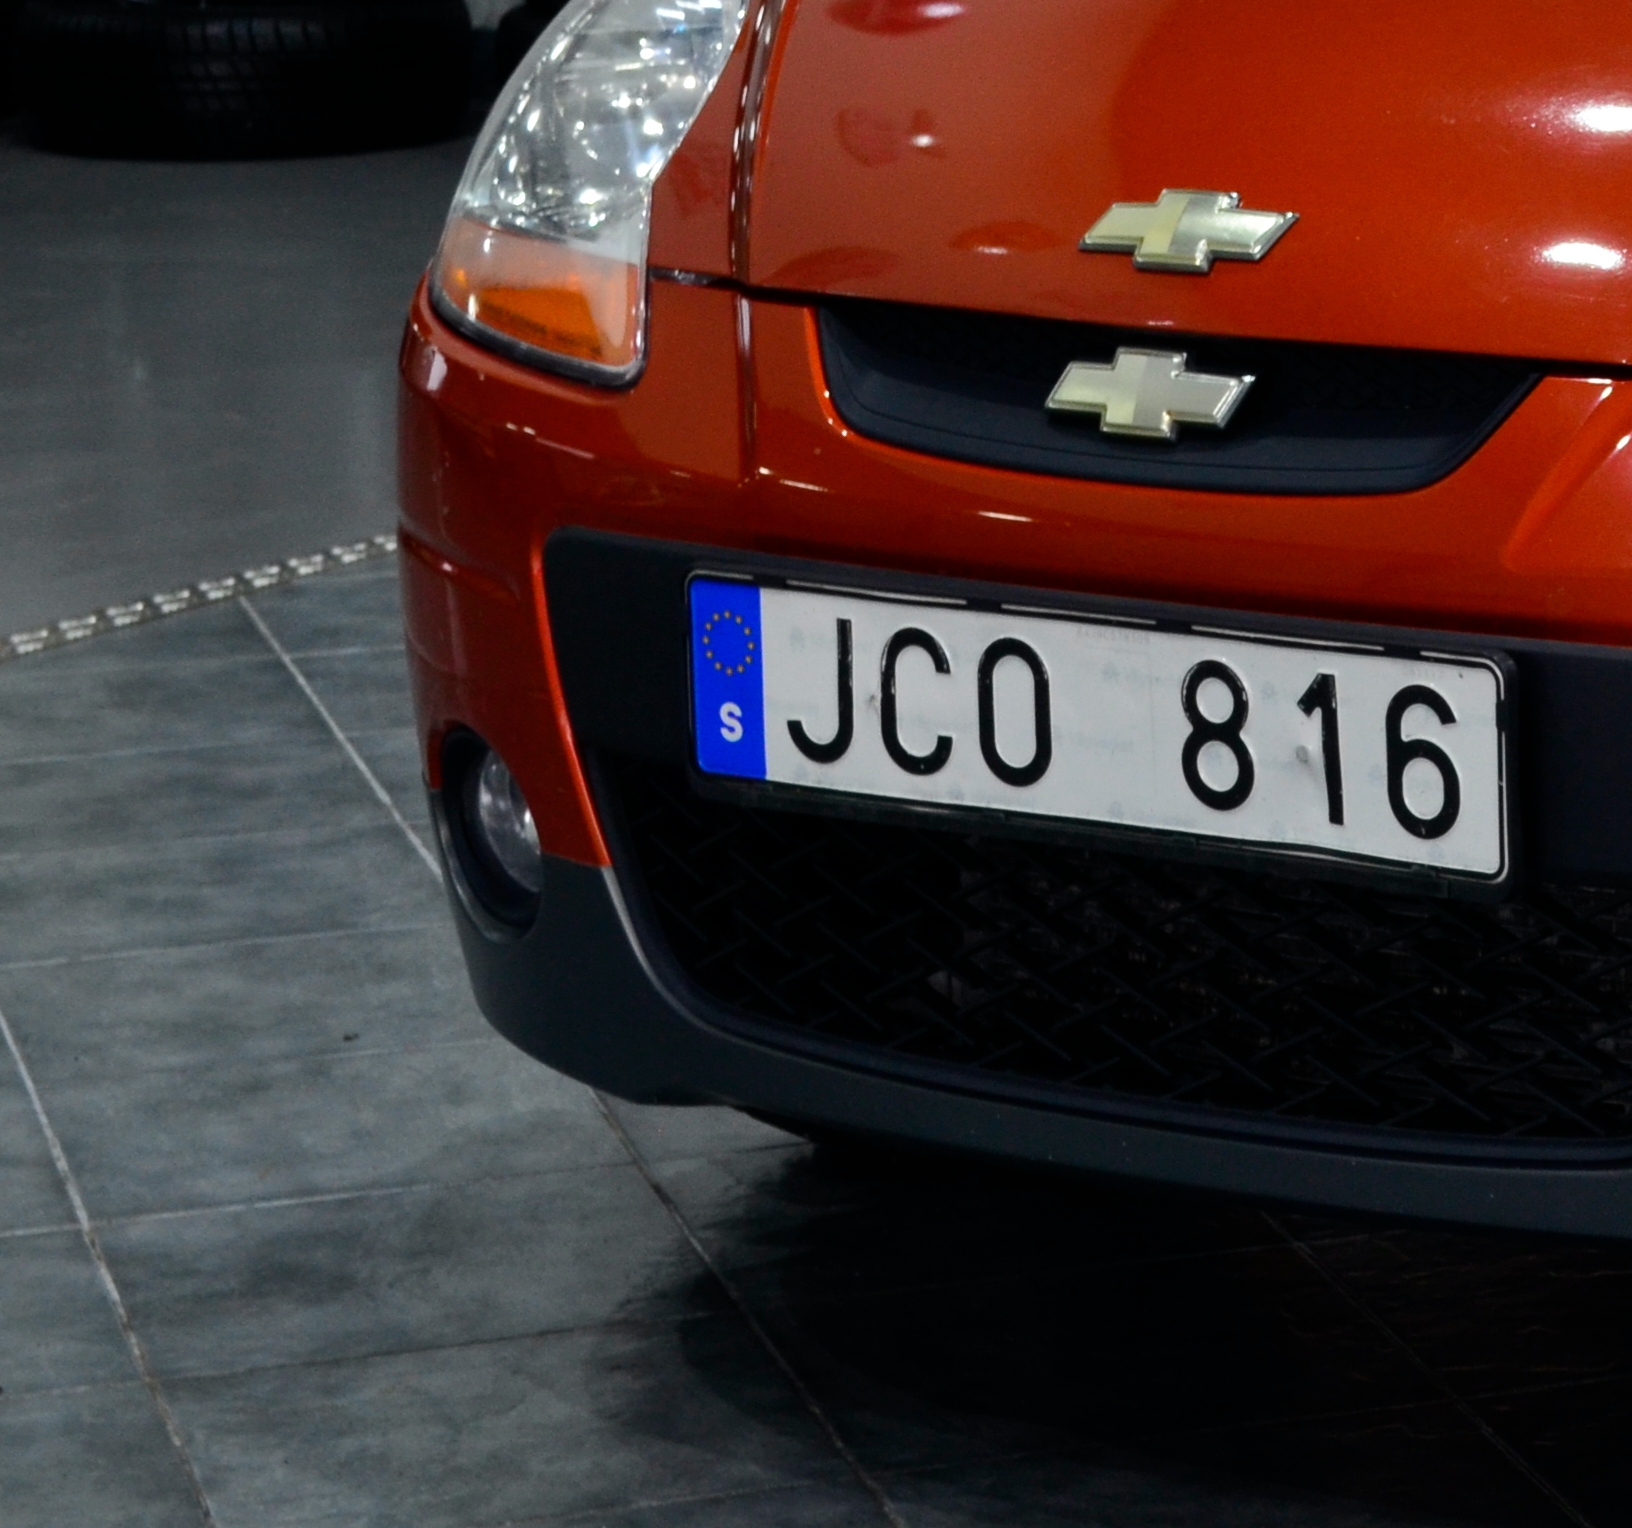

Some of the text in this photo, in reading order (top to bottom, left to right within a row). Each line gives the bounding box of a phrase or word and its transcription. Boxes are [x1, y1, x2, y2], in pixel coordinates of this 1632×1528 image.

[719, 701, 744, 743] S
[787, 617, 1461, 840] JCO 816
